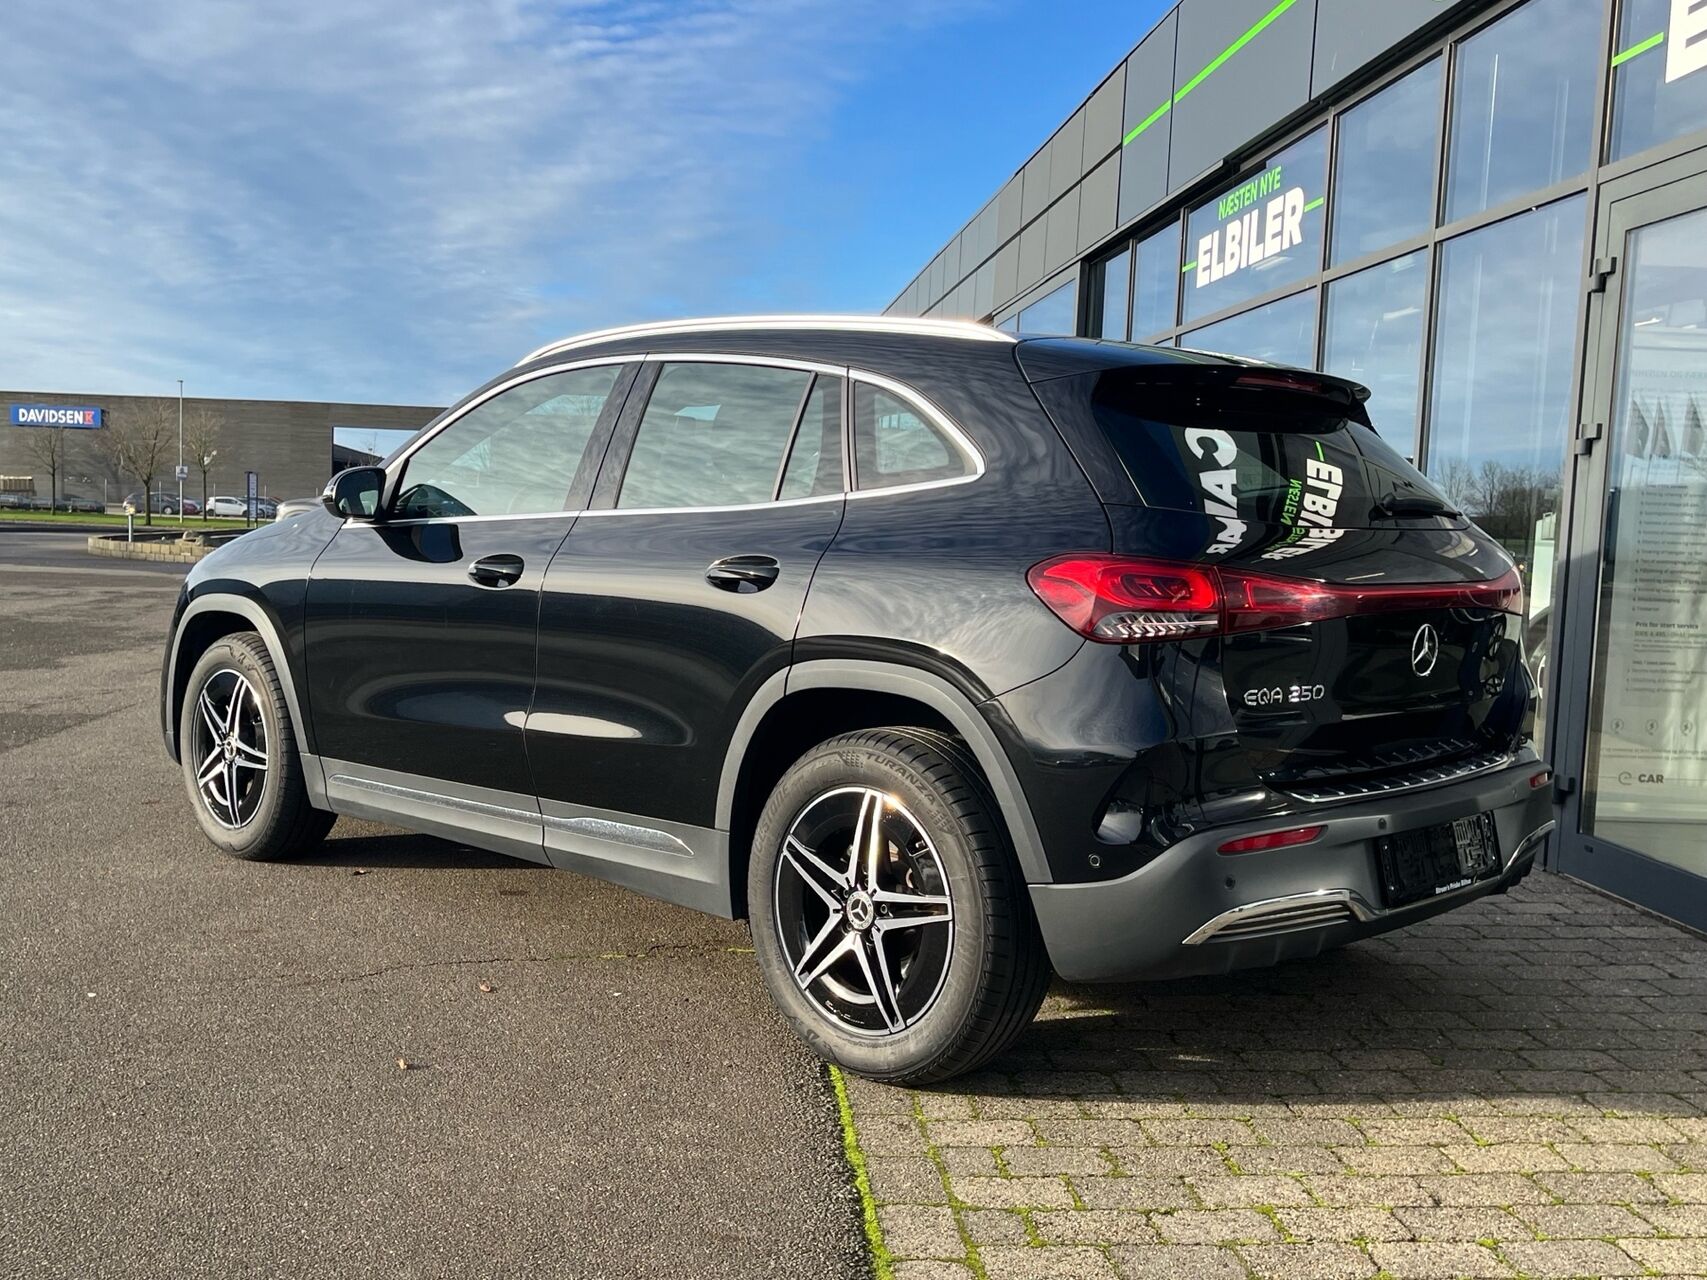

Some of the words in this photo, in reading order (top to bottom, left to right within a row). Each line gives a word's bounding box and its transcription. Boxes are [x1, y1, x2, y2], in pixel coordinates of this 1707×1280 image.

[1218, 180, 1258, 221] NÆSTEN
[1260, 166, 1282, 198] NYE
[1196, 187, 1304, 289] ELBILER
[1243, 687, 1283, 706] EQA
[1288, 684, 1325, 703] 250
[865, 751, 936, 806] TURANZA
[1637, 773, 1664, 784] CAR
